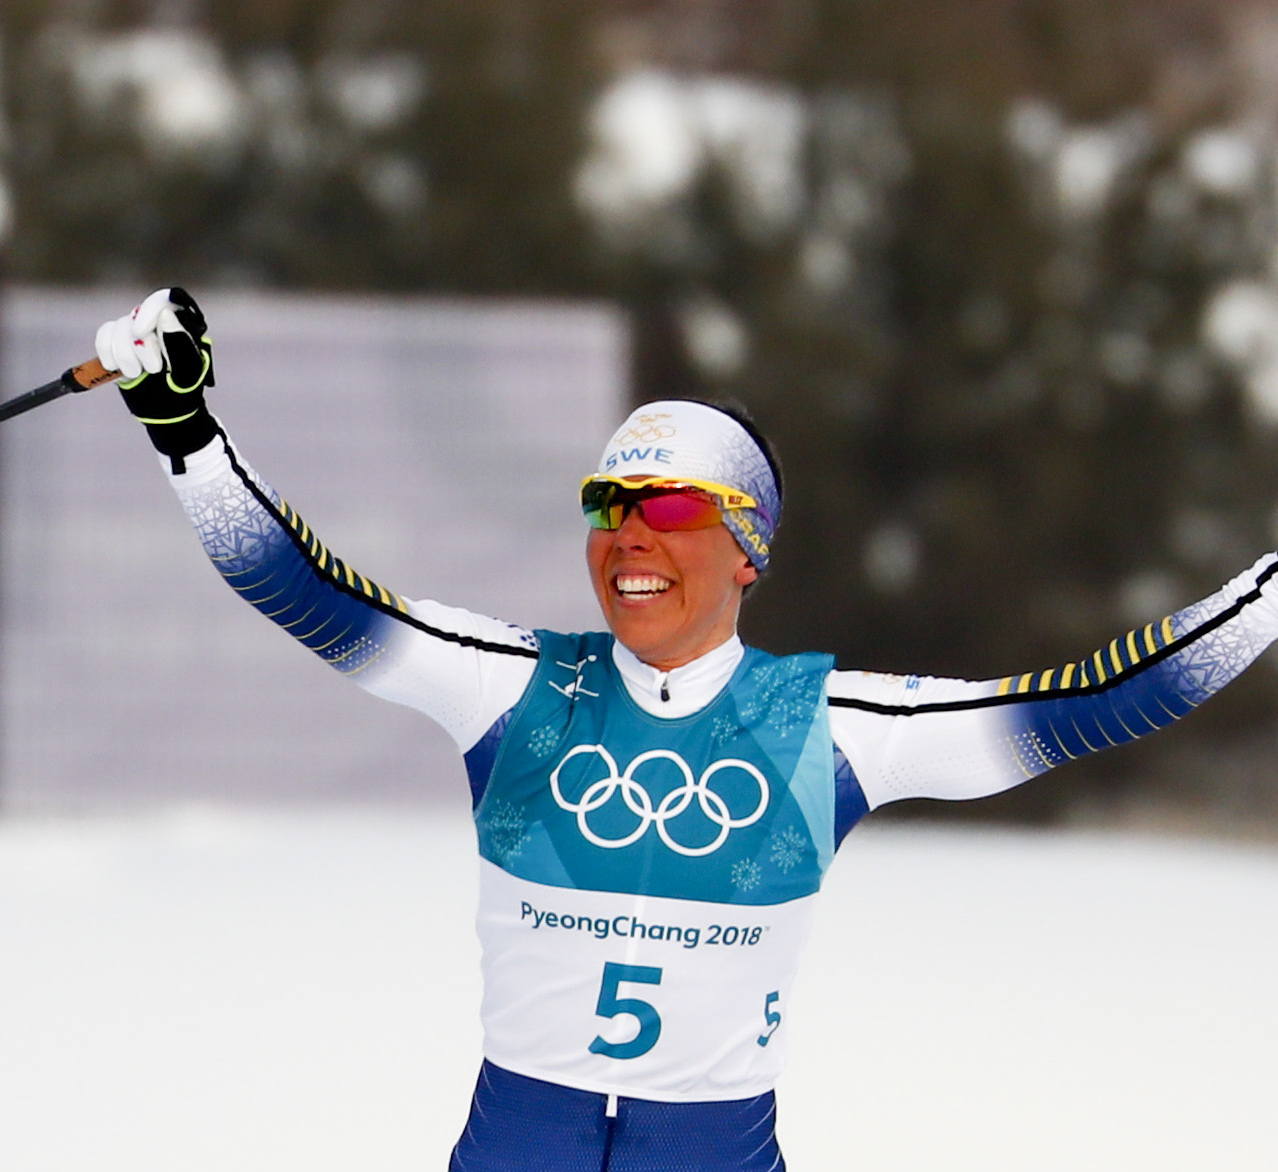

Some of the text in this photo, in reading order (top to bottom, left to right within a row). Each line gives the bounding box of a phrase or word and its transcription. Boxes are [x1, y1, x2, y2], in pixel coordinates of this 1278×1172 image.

[606, 448, 674, 472] SWE
[520, 900, 763, 949] PyeongChang 2018
[587, 961, 663, 1060] 5
[757, 989, 782, 1048] 5
